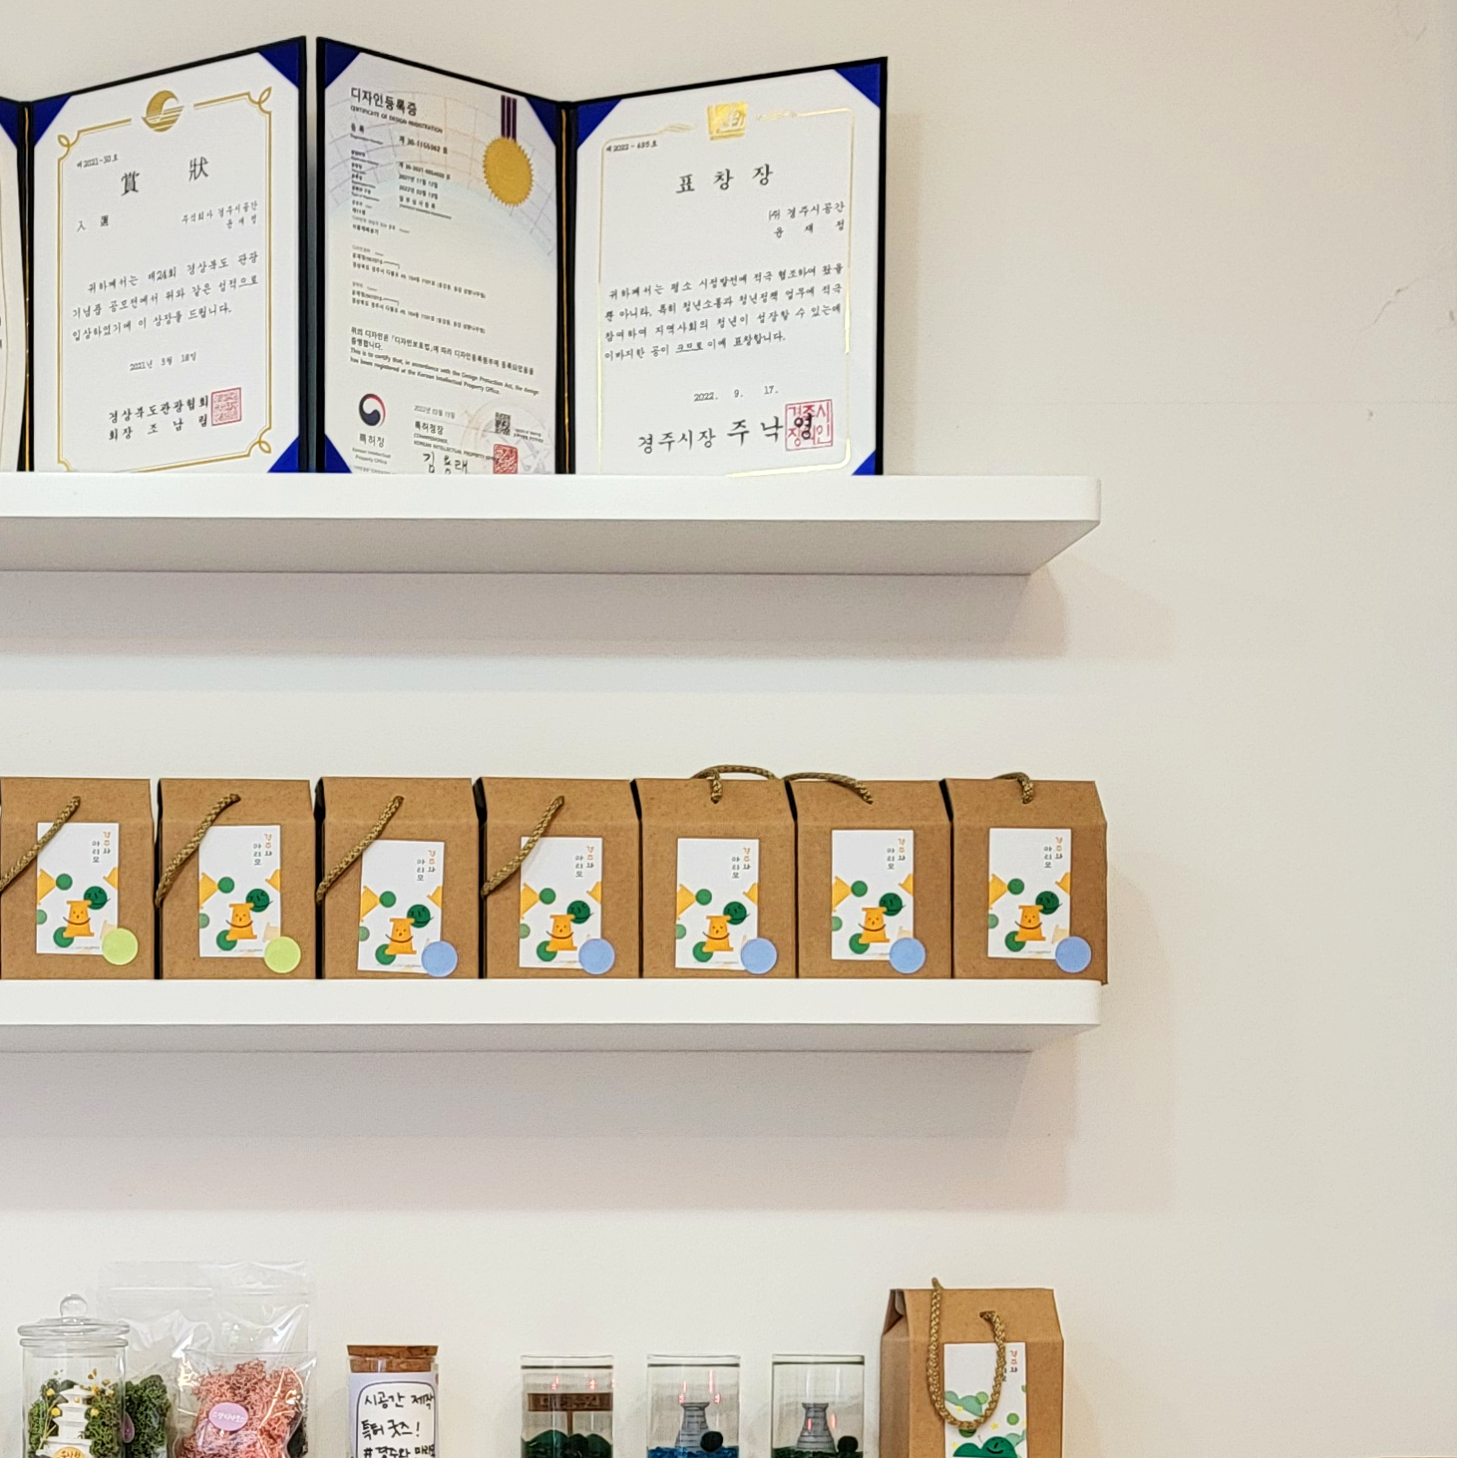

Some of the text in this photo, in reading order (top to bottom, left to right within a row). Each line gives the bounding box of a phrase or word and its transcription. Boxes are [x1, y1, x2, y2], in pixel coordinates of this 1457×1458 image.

[350, 86, 418, 117] 디자인등록증
[786, 200, 846, 219] 경주시공간
[186, 257, 229, 276] 경상북도
[237, 250, 259, 266] 관광
[670, 281, 693, 294] 평소
[699, 273, 748, 289] 시정발전에
[753, 270, 773, 283] 적극
[778, 265, 817, 282] 협조하여
[72, 303, 102, 319] 기념품
[619, 305, 653, 320] 아니라,
[657, 302, 676, 316] 특히
[683, 295, 733, 313] 청년소통과
[739, 289, 779, 306] 청년정책
[785, 286, 815, 301] 업무에
[822, 283, 843, 295] 적극
[138, 316, 147, 330] 이
[152, 311, 182, 328] 상장을
[188, 302, 233, 321] 드립니다.
[605, 303, 841, 343] 참여하여 지역사회의 청년이 성장할 수 있는데
[604, 330, 786, 362] 이바지한 공이 크므로 이에 표창합니다.
[693, 385, 778, 402] 2022. 9. 17.
[108, 423, 134, 442] 회장
[414, 420, 445, 436] 특허청장
[638, 427, 717, 454] 경주시장
[359, 433, 385, 449] 특허청
[91, 839, 101, 864] 마리모
[102, 831, 112, 855] 경주와
[252, 842, 262, 867] 마리모
[263, 833, 273, 857] 경주와
[897, 837, 906, 862] 경주와
[1054, 835, 1064, 860] 경주와
[415, 857, 426, 882] 마리모
[427, 849, 437, 874] 경주와
[574, 853, 584, 878] 마리모
[586, 845, 595, 869] 경주와
[730, 855, 741, 879] 마리모
[741, 846, 751, 871] 경주와
[886, 846, 896, 871] 마리모
[1043, 845, 1054, 869] 마리모
[1008, 1349, 1019, 1374] 경주와
[364, 1391, 435, 1411] 시공간 제작
[361, 1418, 421, 1441] 특허 굿즈!
